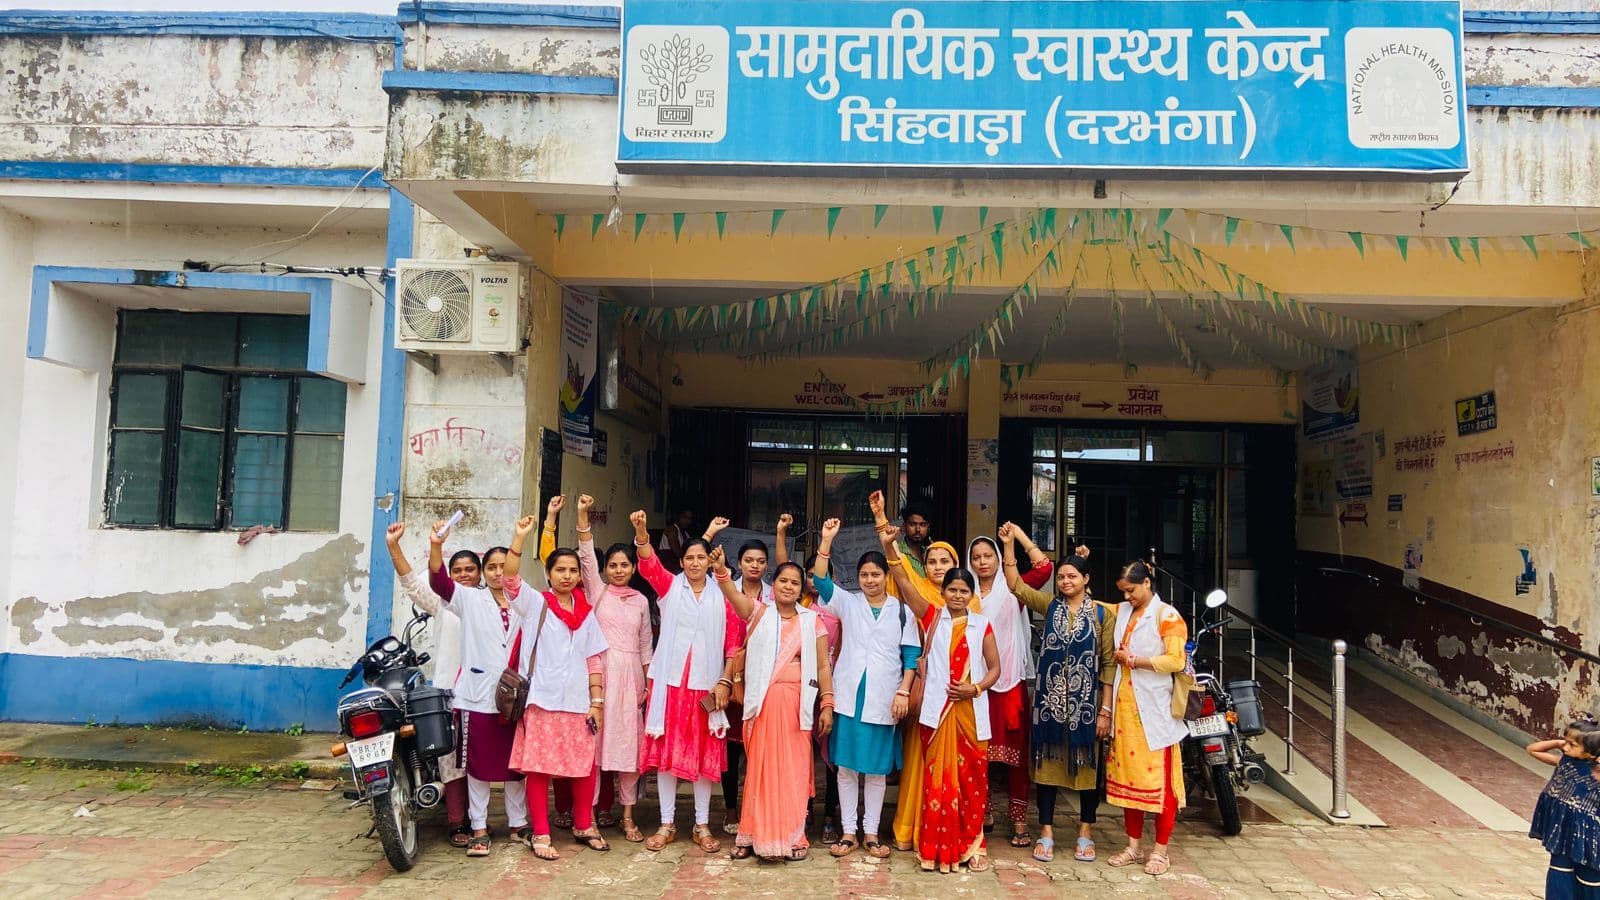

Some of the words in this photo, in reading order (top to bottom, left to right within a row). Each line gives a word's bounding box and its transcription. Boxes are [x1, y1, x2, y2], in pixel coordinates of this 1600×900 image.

[736, 8, 999, 100] सामुदायिक
[1012, 28, 1192, 82] स्वास्थ्य
[1204, 11, 1329, 88] केन्द्र
[1352, 52, 1380, 115] NATIONAL
[1381, 43, 1428, 63] HEALTH
[1428, 58, 1454, 115] MISSION
[635, 127, 668, 137] बिहार
[671, 129, 714, 138] सरकार
[838, 96, 1026, 157] सिंहवाड़ा
[1045, 96, 1257, 160] (दरभंगा)
[1392, 132, 1417, 142] स्वास्थ्य
[1418, 132, 1439, 142] मिशन
[804, 382, 847, 393] ENTRY
[1128, 385, 1160, 402] प्रवेश
